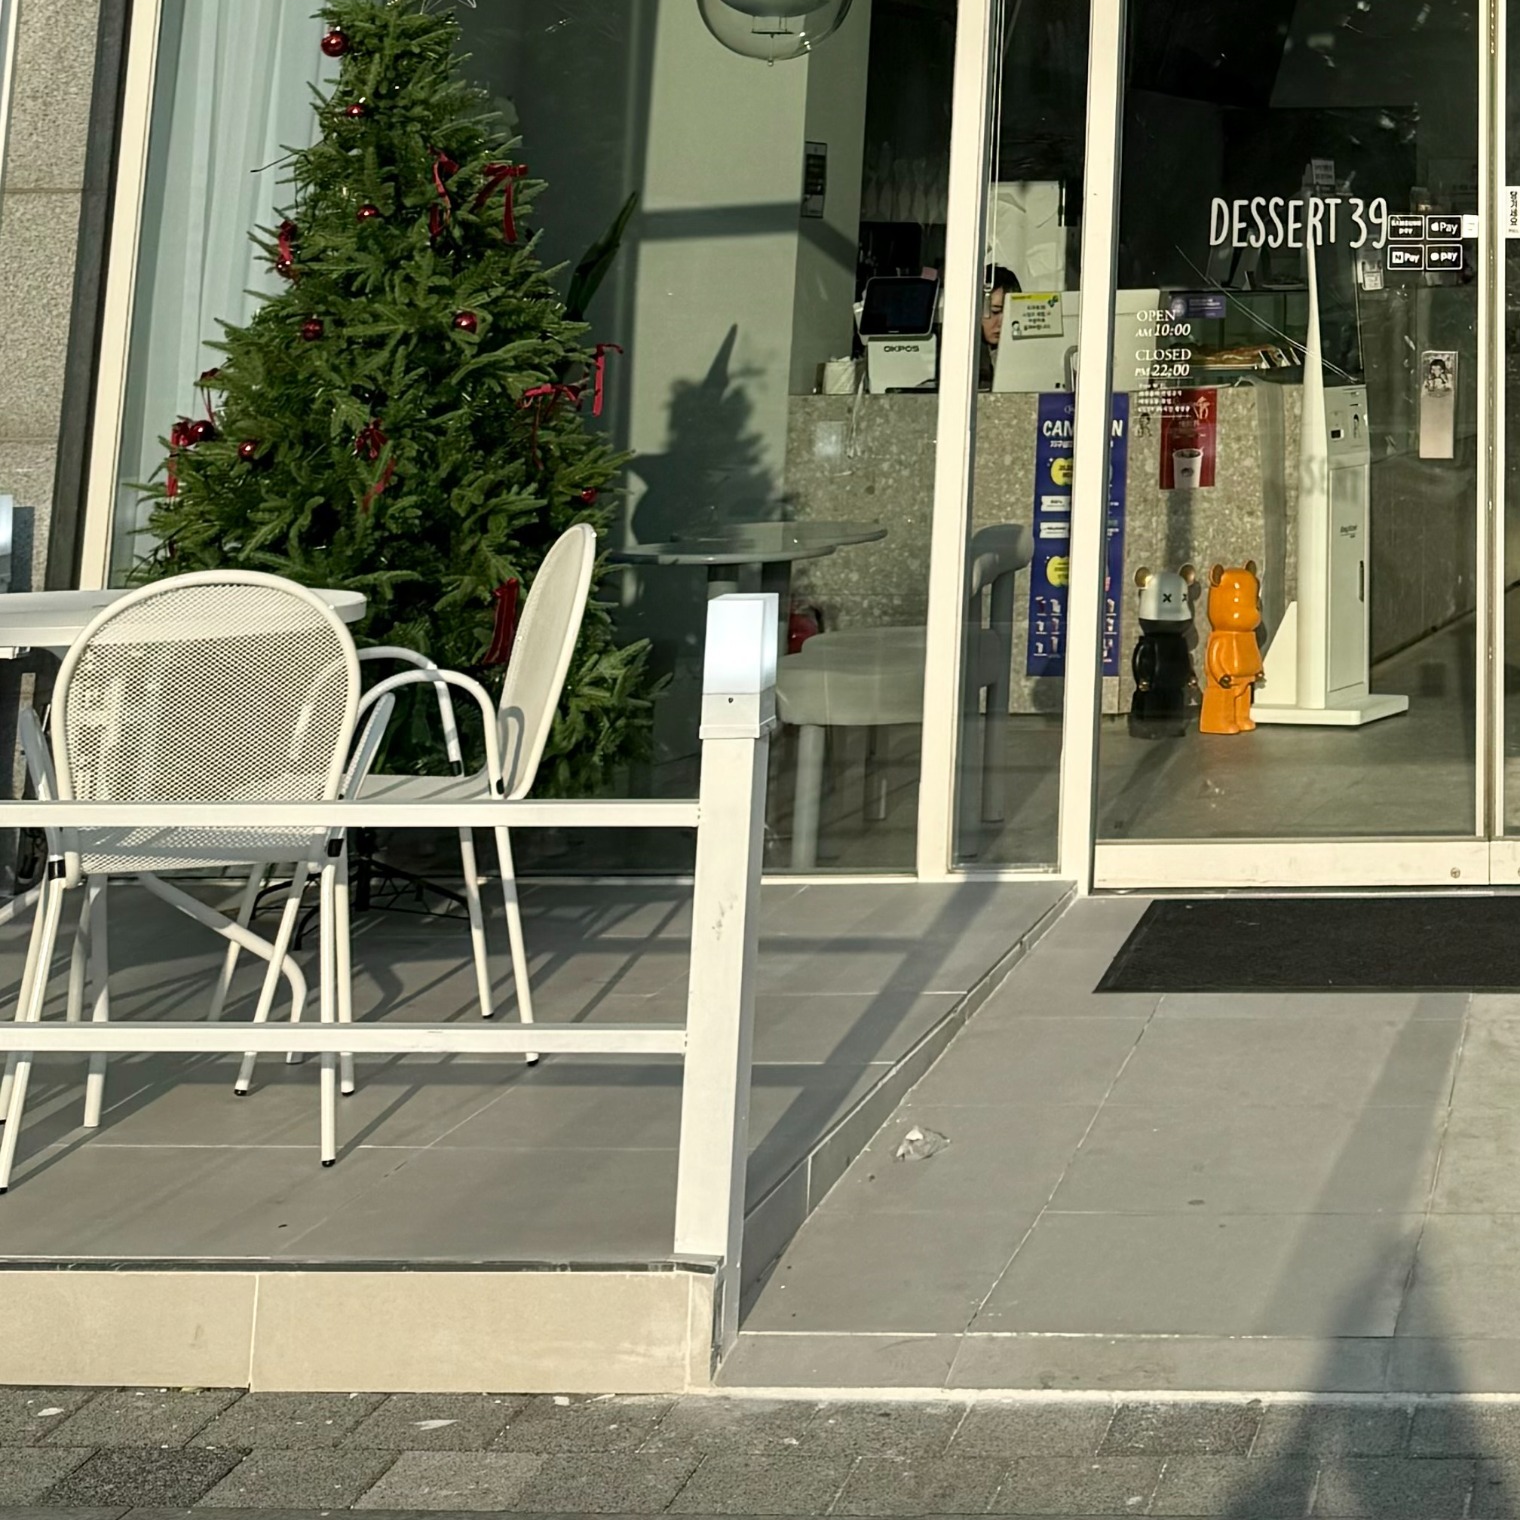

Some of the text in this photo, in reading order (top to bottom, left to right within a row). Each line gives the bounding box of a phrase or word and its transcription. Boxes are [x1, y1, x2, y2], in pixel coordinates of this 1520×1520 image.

[1209, 196, 1388, 249] DESSERT 39
[1440, 221, 1459, 235] Pay
[1404, 252, 1421, 264] Pay
[1440, 251, 1459, 262] pay
[1136, 309, 1176, 321] OPEN
[1135, 323, 1192, 337] AM 10:00
[1135, 348, 1192, 361] CLOSED
[1151, 364, 1190, 377] 22:00
